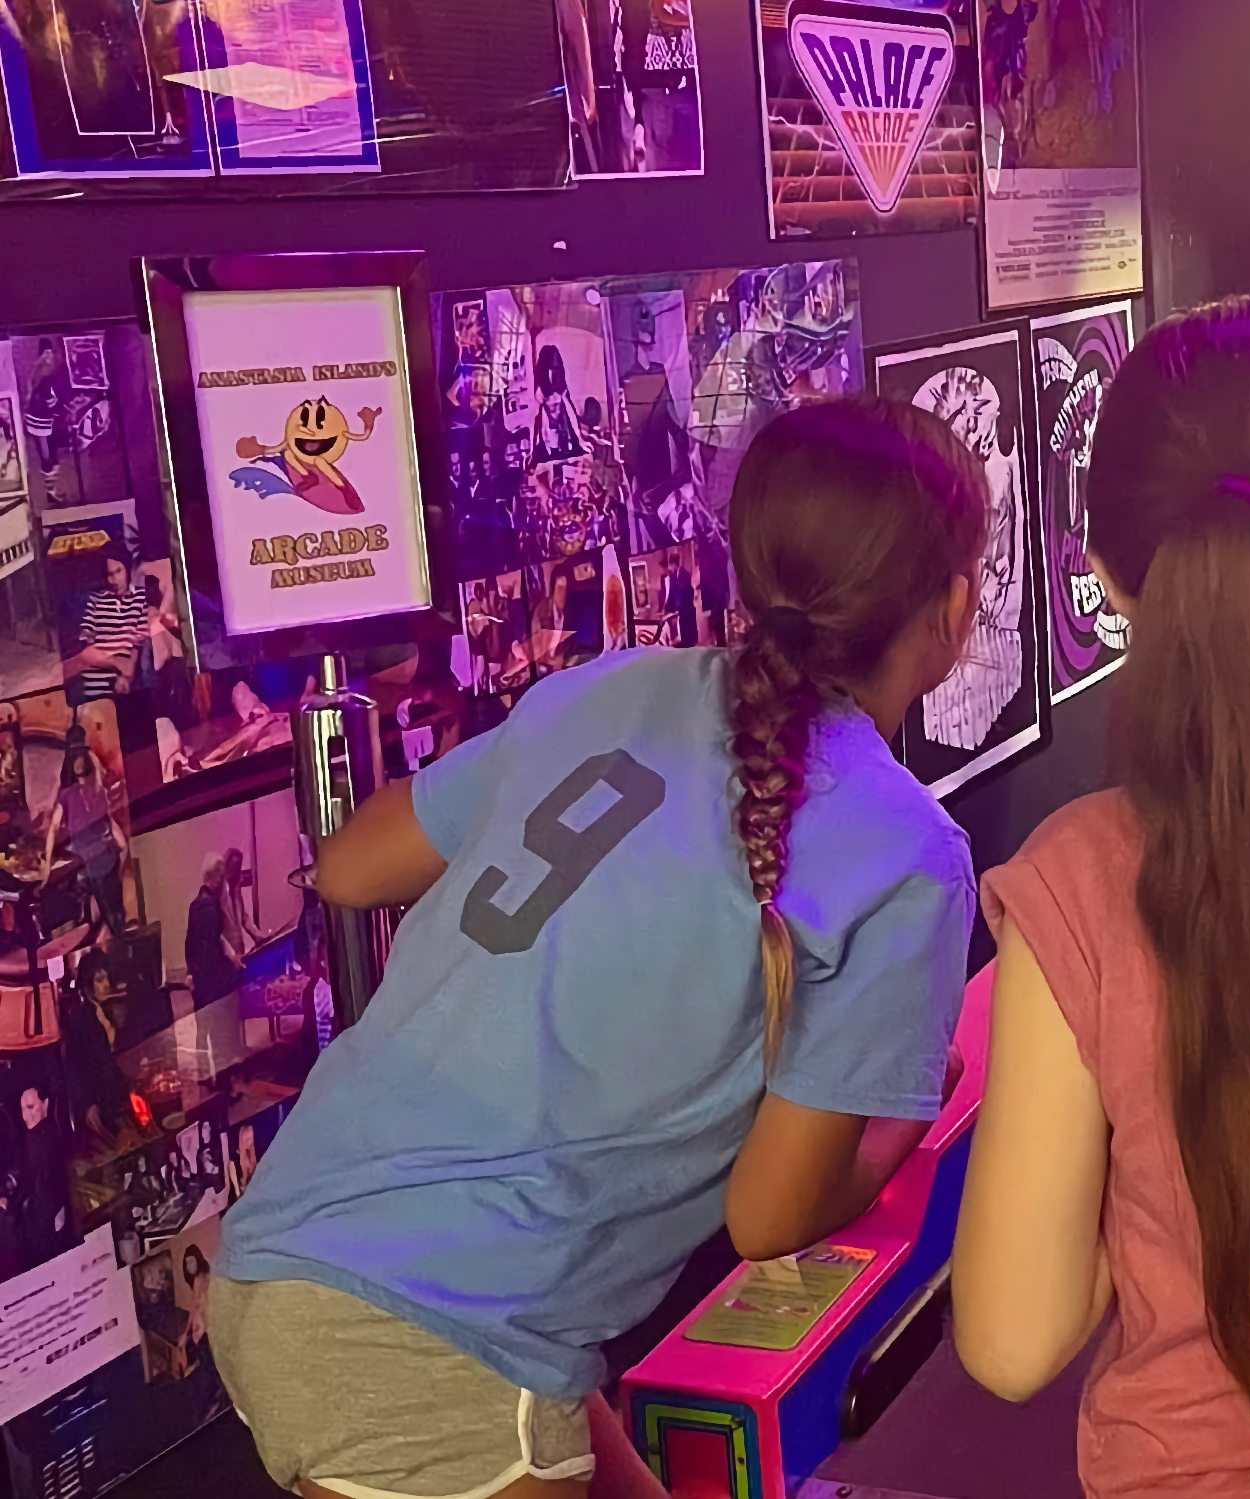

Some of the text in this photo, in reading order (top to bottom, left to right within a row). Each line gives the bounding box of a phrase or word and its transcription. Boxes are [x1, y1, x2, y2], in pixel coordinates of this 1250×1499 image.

[800, 32, 946, 109] PALACE
[841, 111, 919, 143] ARCADE
[198, 366, 306, 388] ANASTASIA
[250, 524, 389, 565] ARCADE
[271, 559, 376, 589] MUSEUM
[460, 748, 666, 956] 9
